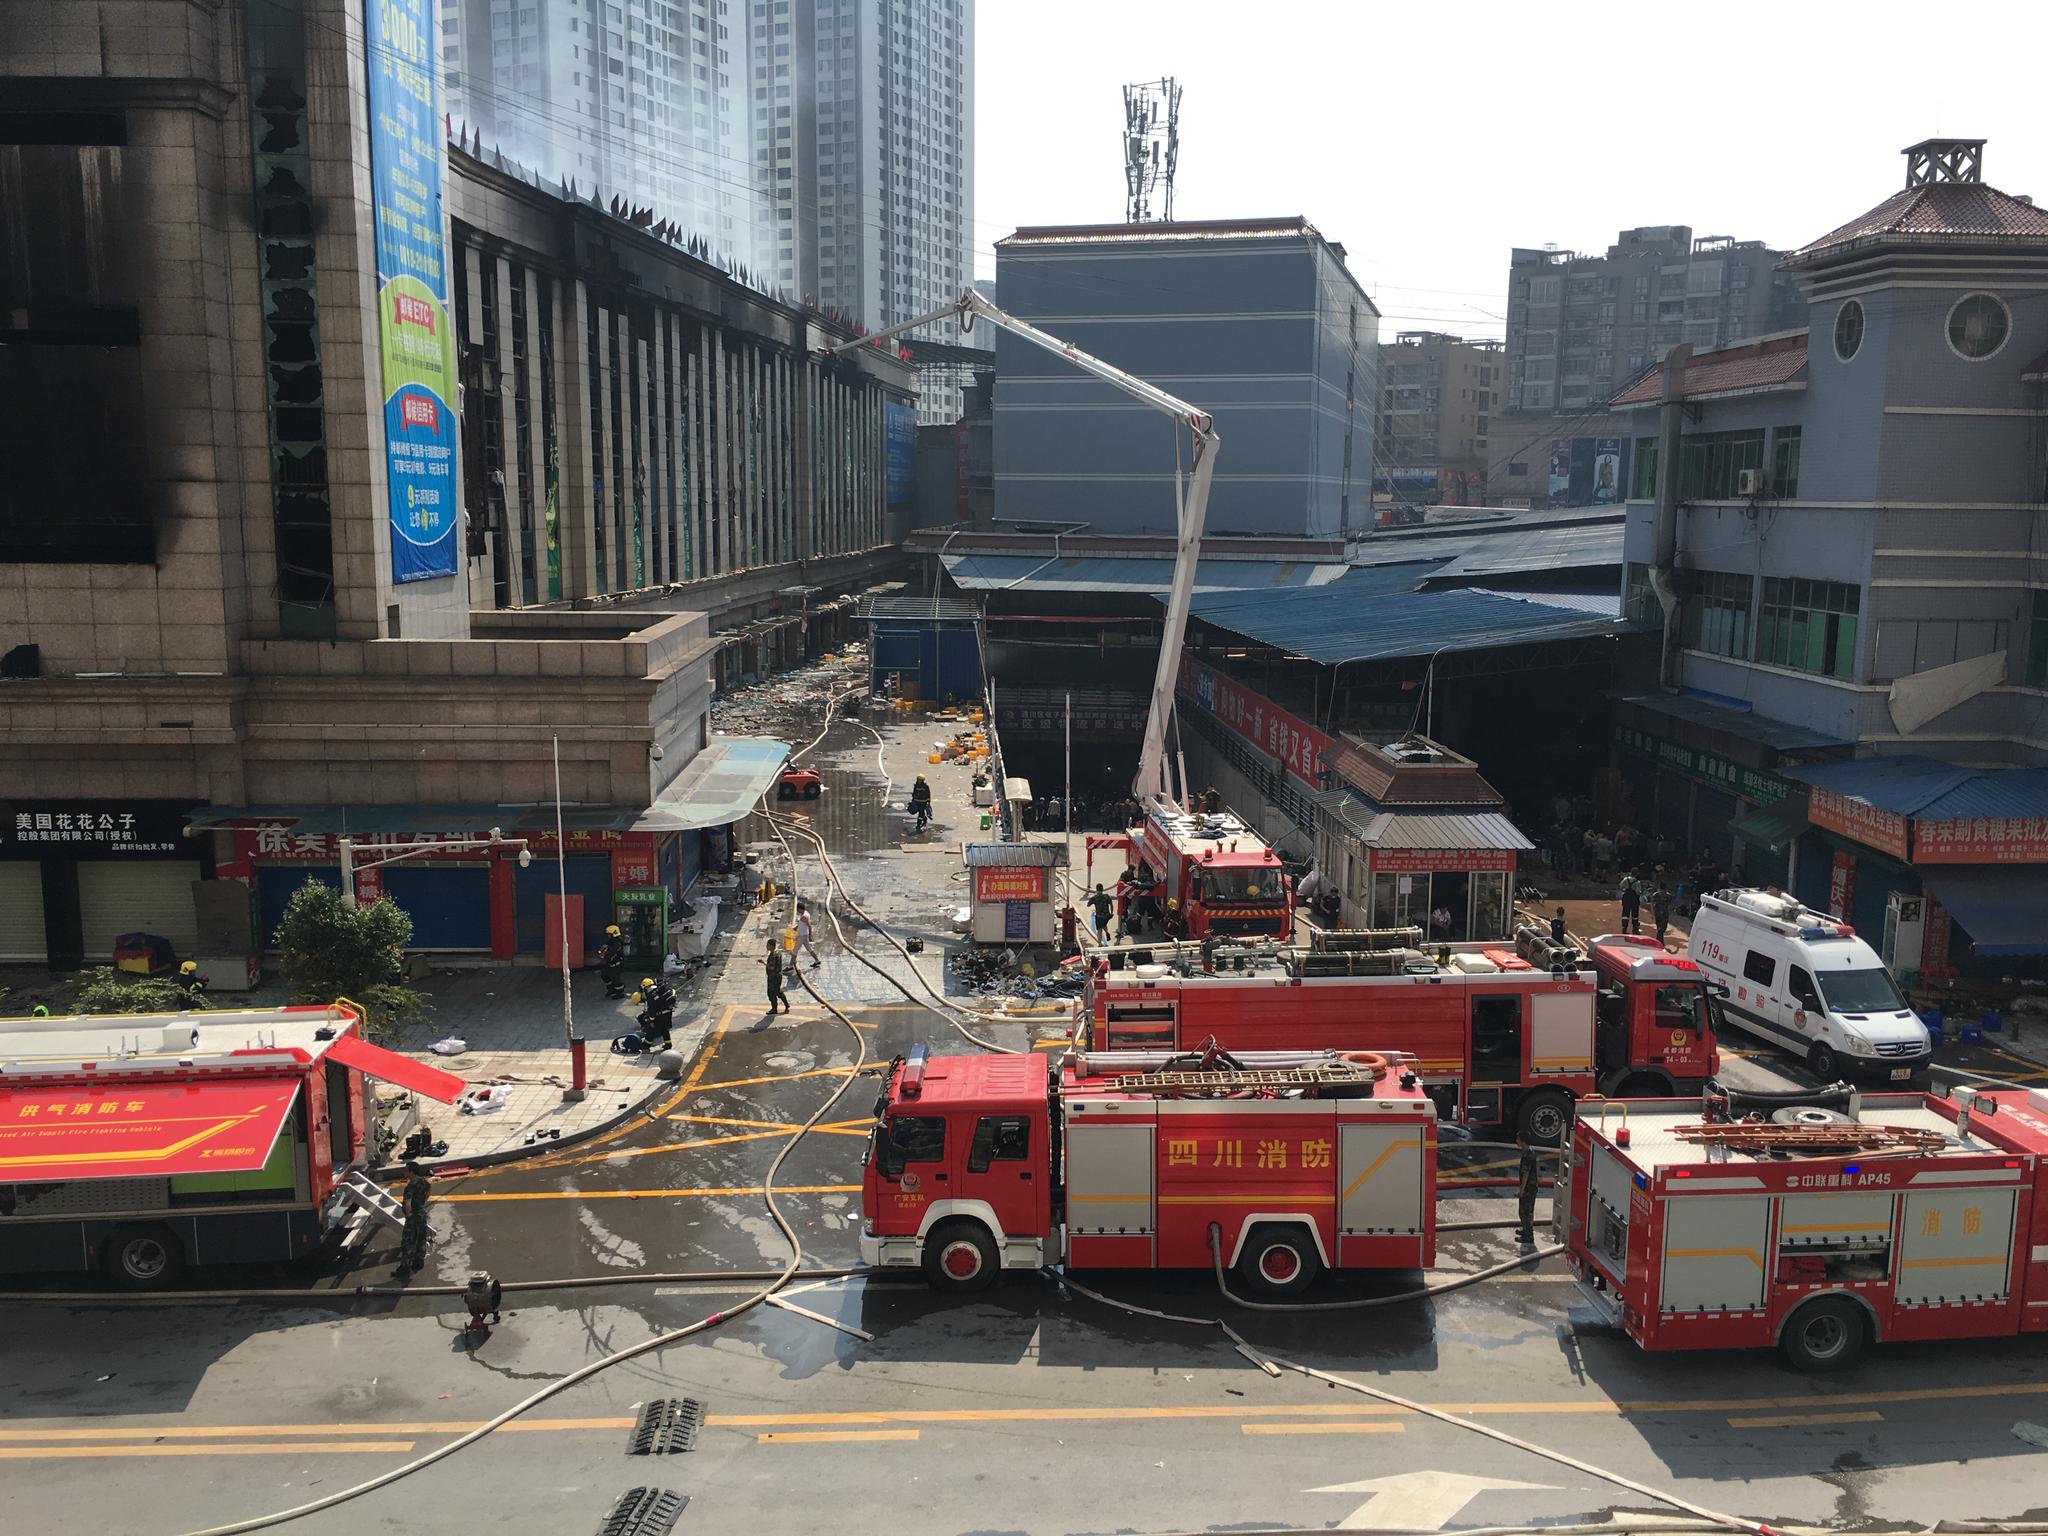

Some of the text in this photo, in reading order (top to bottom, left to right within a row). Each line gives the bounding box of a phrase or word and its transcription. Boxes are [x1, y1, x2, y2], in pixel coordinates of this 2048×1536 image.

[15, 813, 136, 830] 美国花花公子
[17, 831, 137, 841] 控股集团有限公司(授权)
[1701, 940, 1720, 959] 119
[19, 1100, 146, 1117] 供气消防车
[1168, 1139, 1332, 1168] 四川消防
[1802, 1173, 1891, 1187] 中联重科 AP45
[1919, 1206, 1984, 1237] 消防
